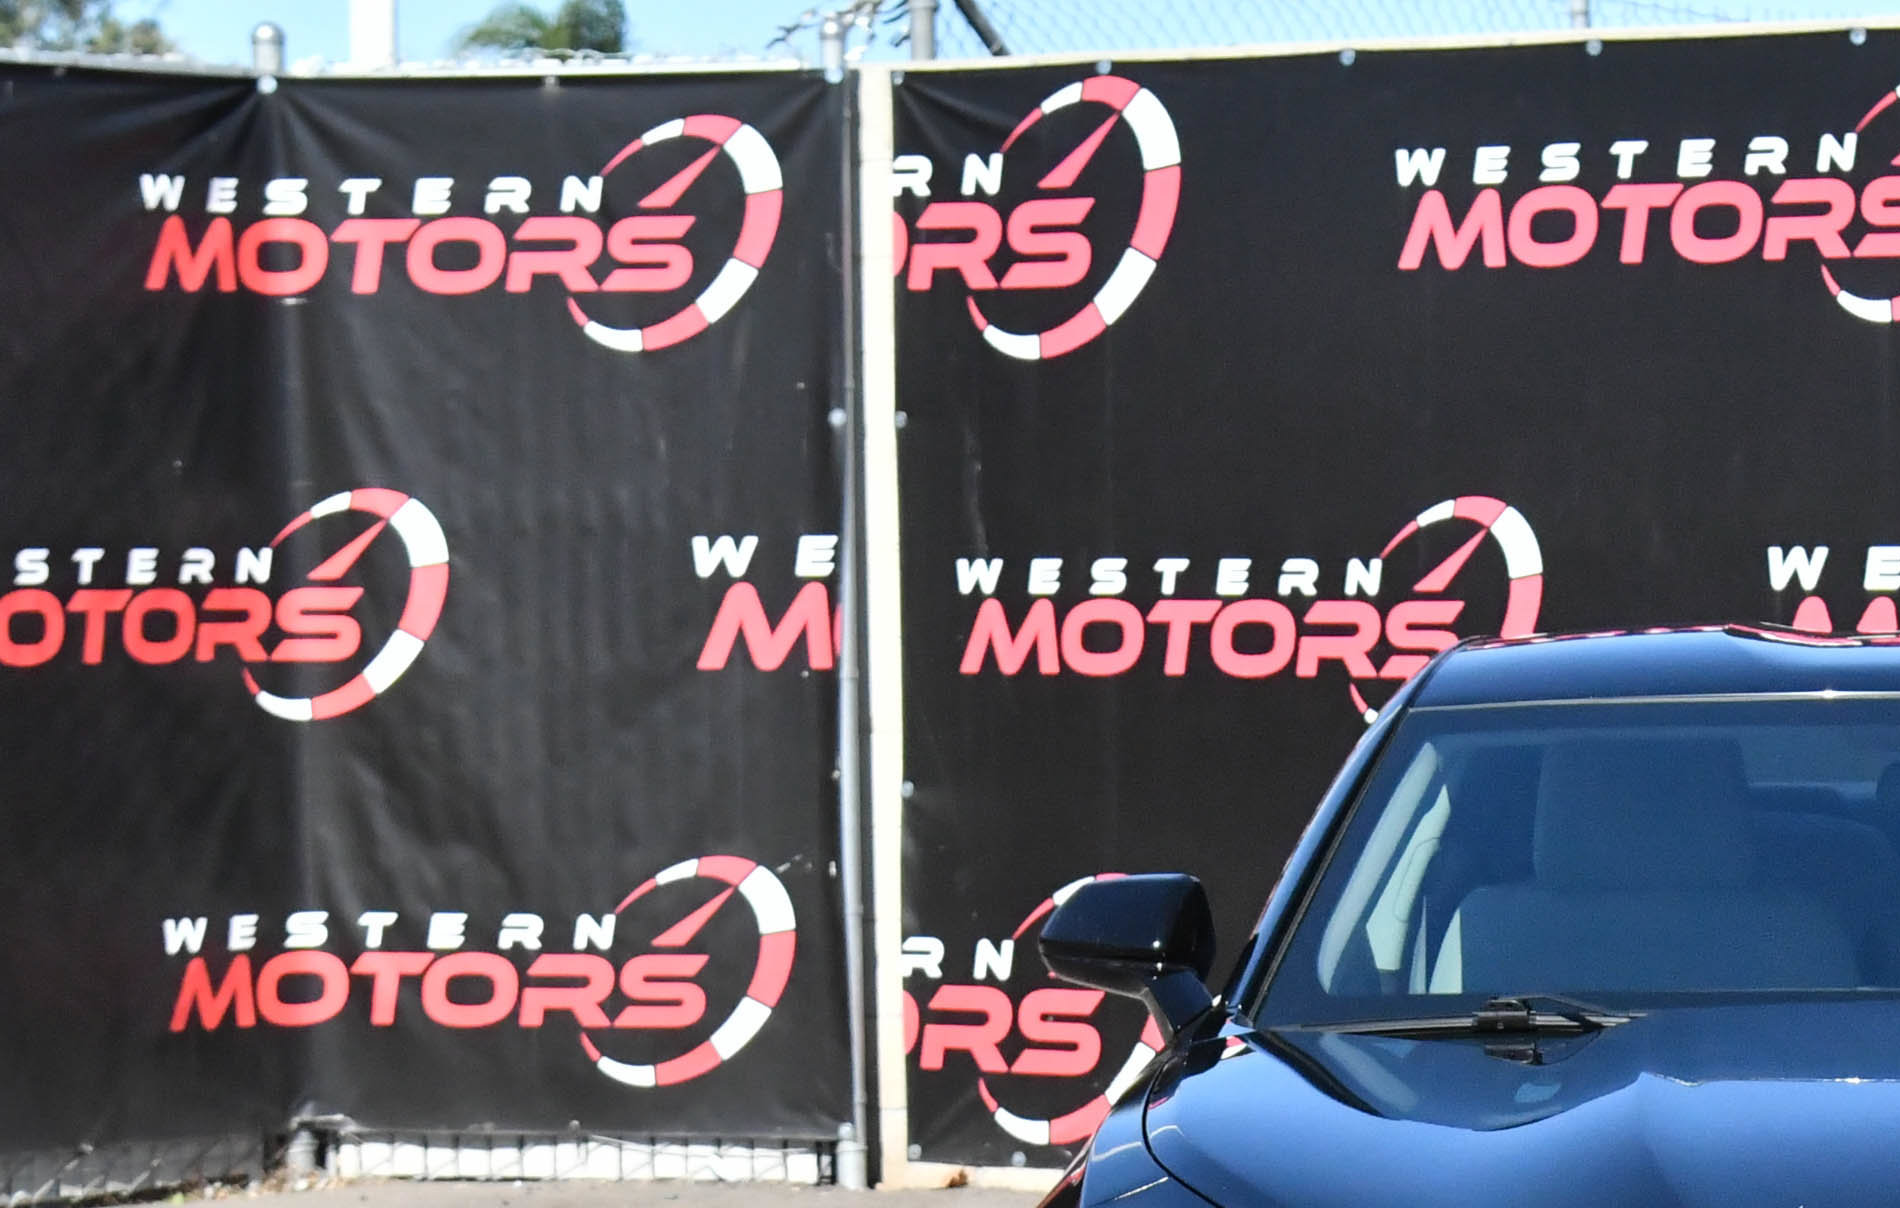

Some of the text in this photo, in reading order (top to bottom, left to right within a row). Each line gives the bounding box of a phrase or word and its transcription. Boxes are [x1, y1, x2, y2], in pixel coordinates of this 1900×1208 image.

[138, 173, 605, 217] WESTERN
[1395, 131, 1860, 188] WESTERN
[143, 213, 698, 297] MOTORS
[893, 197, 1097, 292] RS
[955, 556, 1384, 597] WESTERN
[695, 581, 843, 673] M
[959, 597, 1467, 679] MOTORS
[162, 910, 618, 954] WESTERN
[170, 950, 711, 1033] MOTORS
[902, 984, 1107, 1077] RS
